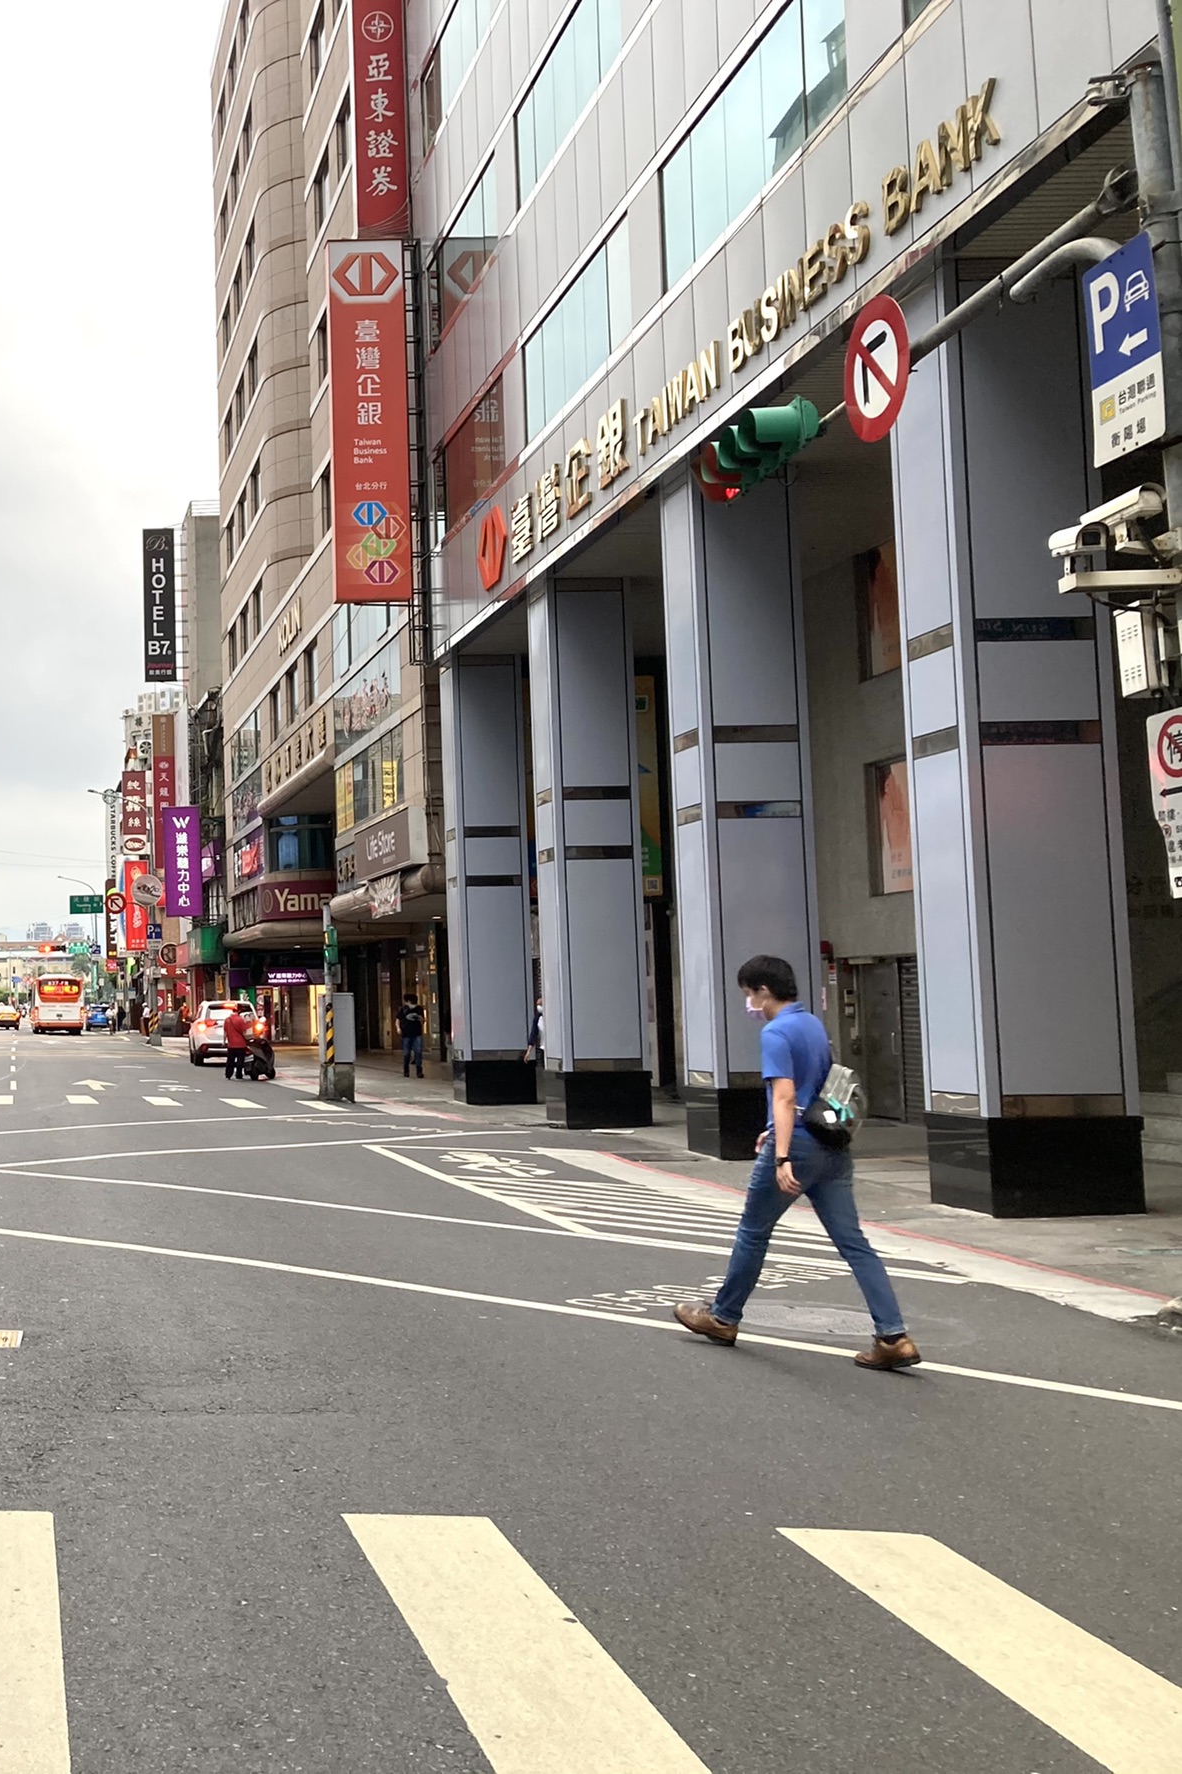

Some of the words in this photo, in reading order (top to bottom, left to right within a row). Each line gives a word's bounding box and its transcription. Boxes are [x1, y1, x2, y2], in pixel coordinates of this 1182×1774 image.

[365, 53, 398, 196] 亞東證券
[632, 340, 720, 456] TAIWAN
[727, 202, 870, 374] BUSINESS
[881, 77, 1001, 236] BANK
[1089, 271, 1120, 355] P
[354, 319, 383, 426] 臺灣企銀
[353, 438, 382, 447] Taiwan
[353, 447, 388, 456] Business
[353, 456, 374, 465] Bank
[510, 397, 630, 565] 臺灣企銀
[355, 481, 388, 491] 台北分行
[151, 558, 166, 637] HOTEL
